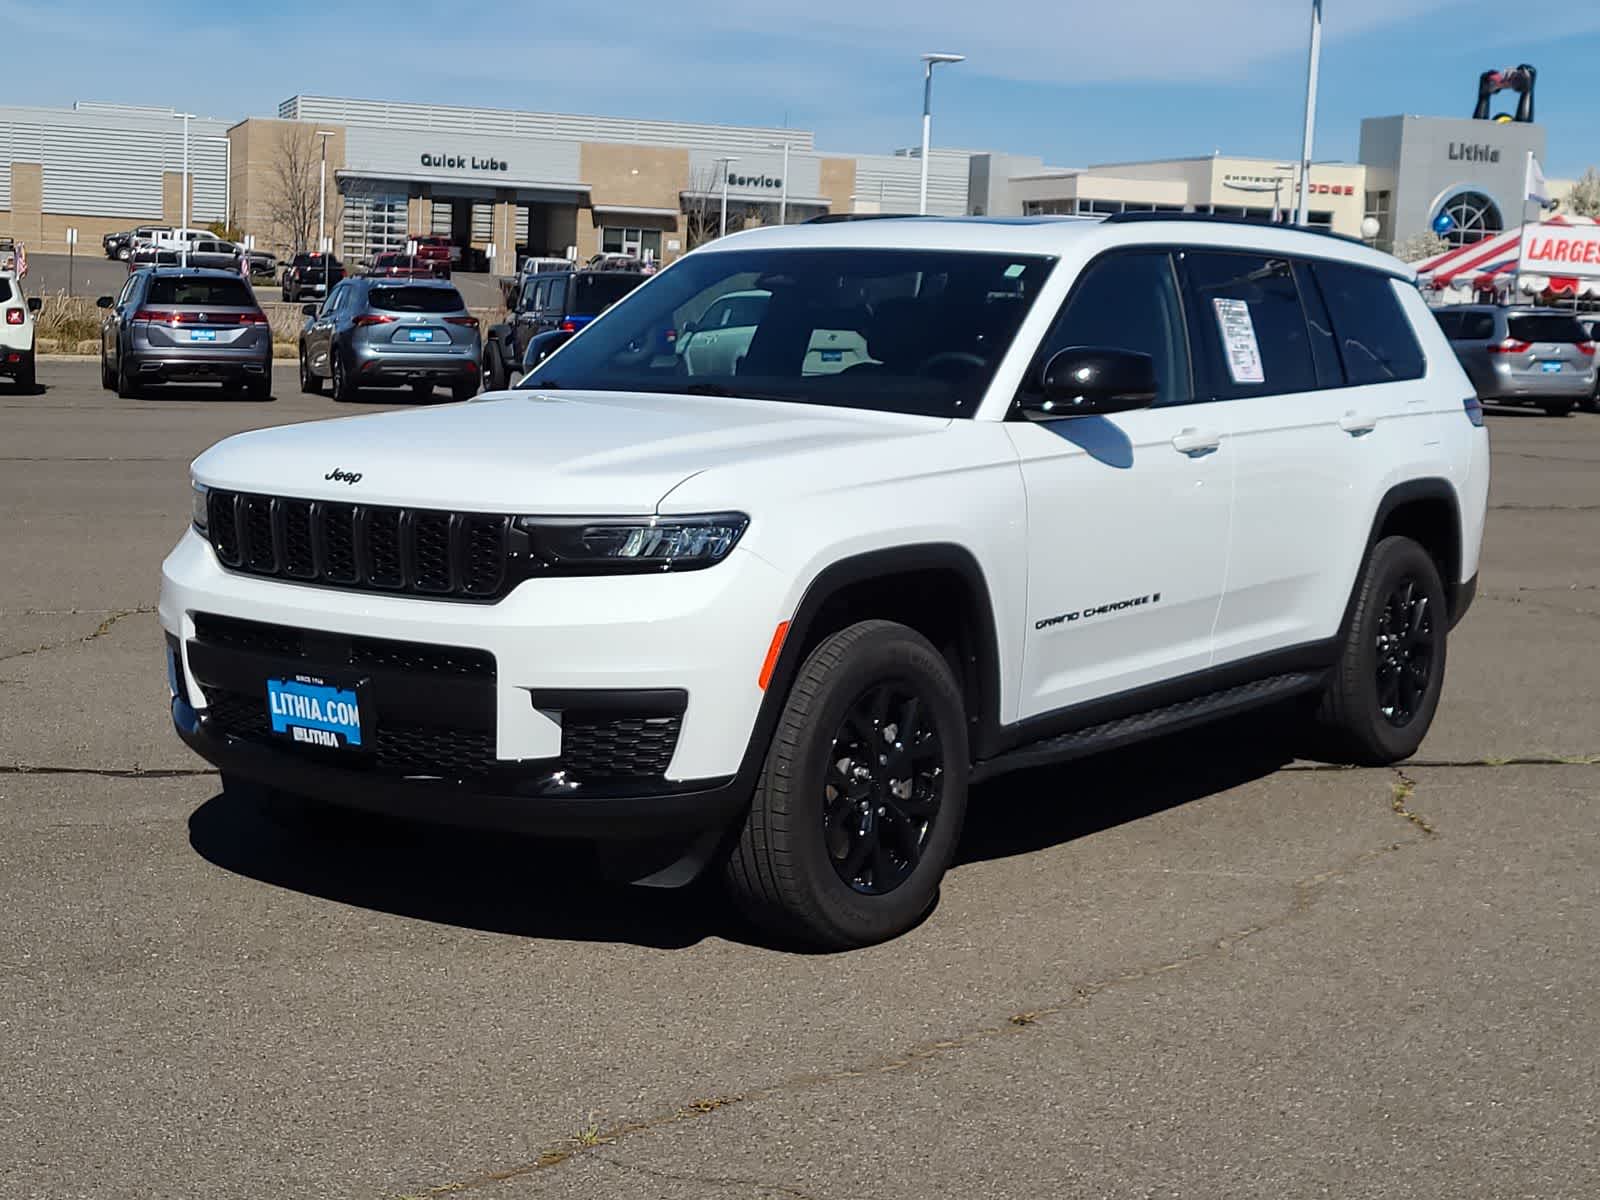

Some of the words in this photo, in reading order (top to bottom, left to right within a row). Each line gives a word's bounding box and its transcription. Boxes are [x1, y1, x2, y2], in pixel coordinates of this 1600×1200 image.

[421, 153, 466, 169] Quick
[471, 156, 508, 171] Lube
[1449, 142, 1500, 163] Lithia
[728, 173, 782, 188] Service
[324, 467, 362, 485] Jeep
[1035, 612, 1080, 630] GRAND
[1083, 595, 1150, 618] CHEROKEE
[271, 691, 361, 728] LITHIA.COM
[304, 727, 339, 748] LITHIA
